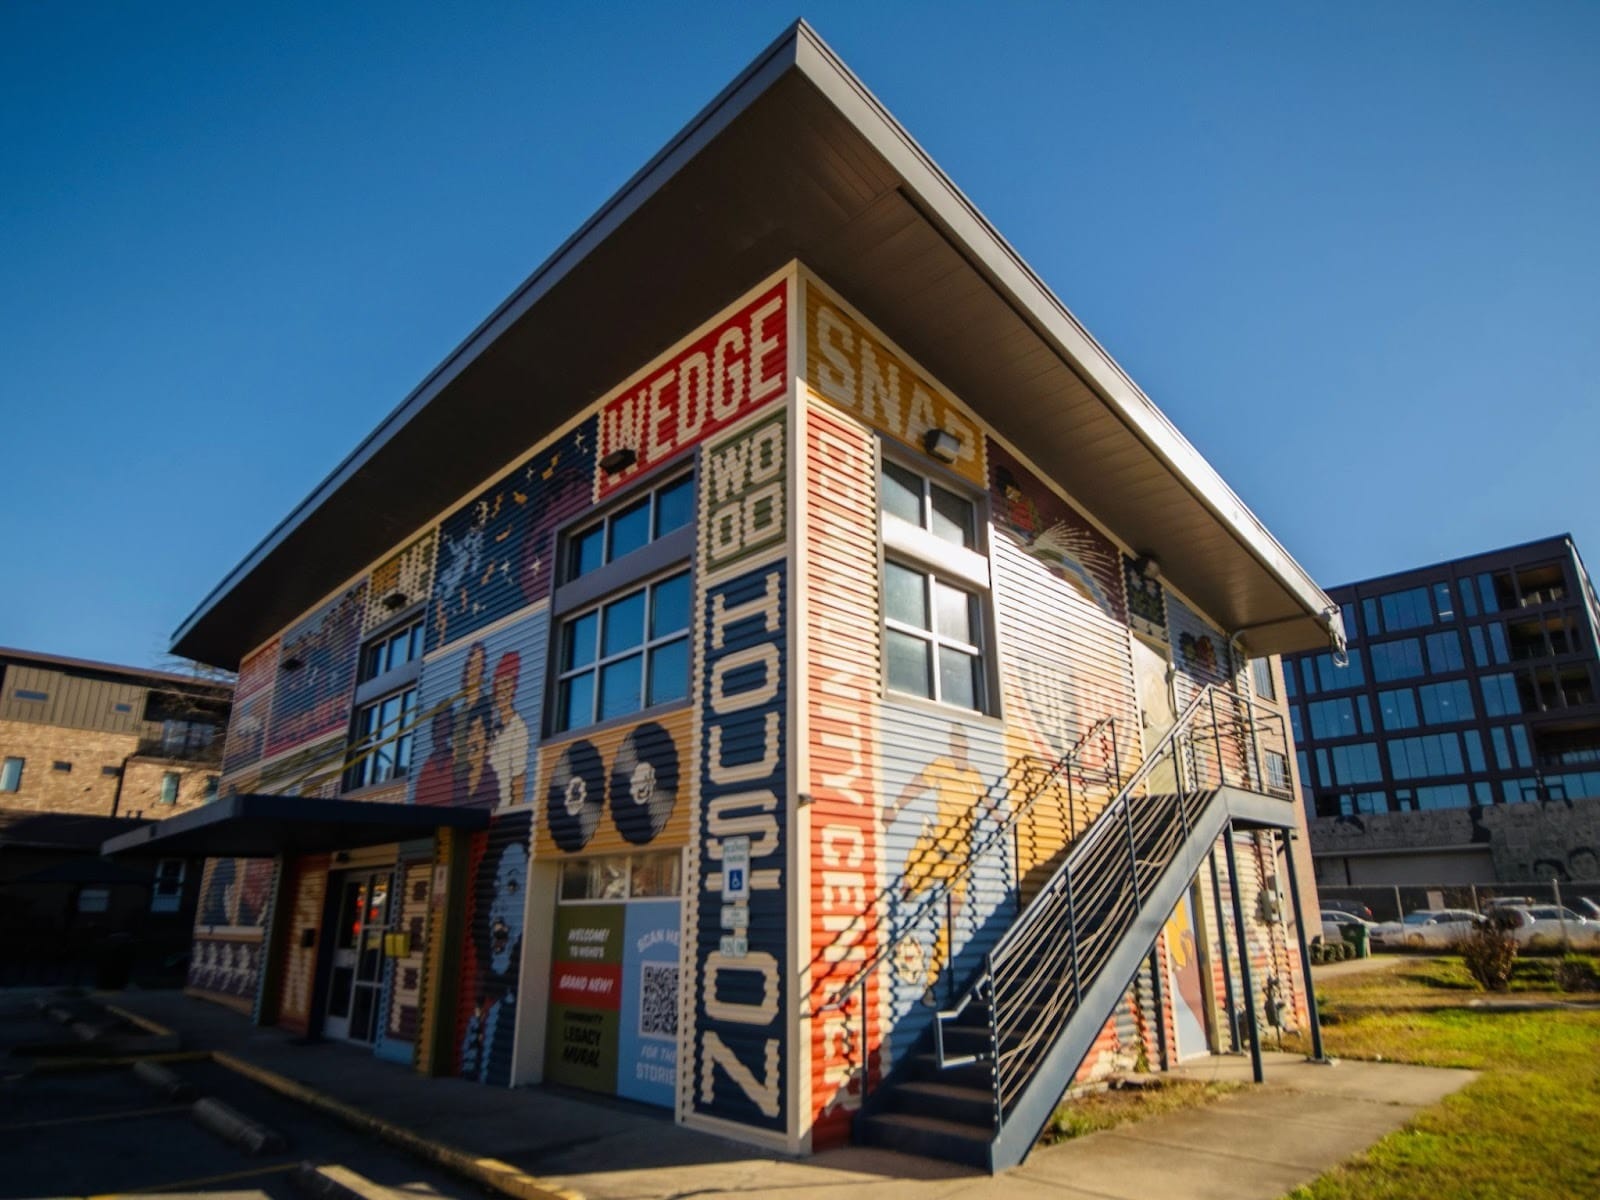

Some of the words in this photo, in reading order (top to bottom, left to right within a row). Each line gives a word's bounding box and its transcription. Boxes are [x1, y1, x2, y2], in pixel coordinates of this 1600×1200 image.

[608, 295, 783, 484] WEDGE
[816, 305, 976, 463] SNAP
[703, 571, 782, 1119] HOUSTON
[637, 928, 665, 953] SCAN
[559, 974, 588, 991] BRAND
[564, 1026, 602, 1046] LEGACY
[563, 1047, 601, 1068] MURAL
[640, 1045, 658, 1059] FOR
[636, 1061, 676, 1087] STORIE
